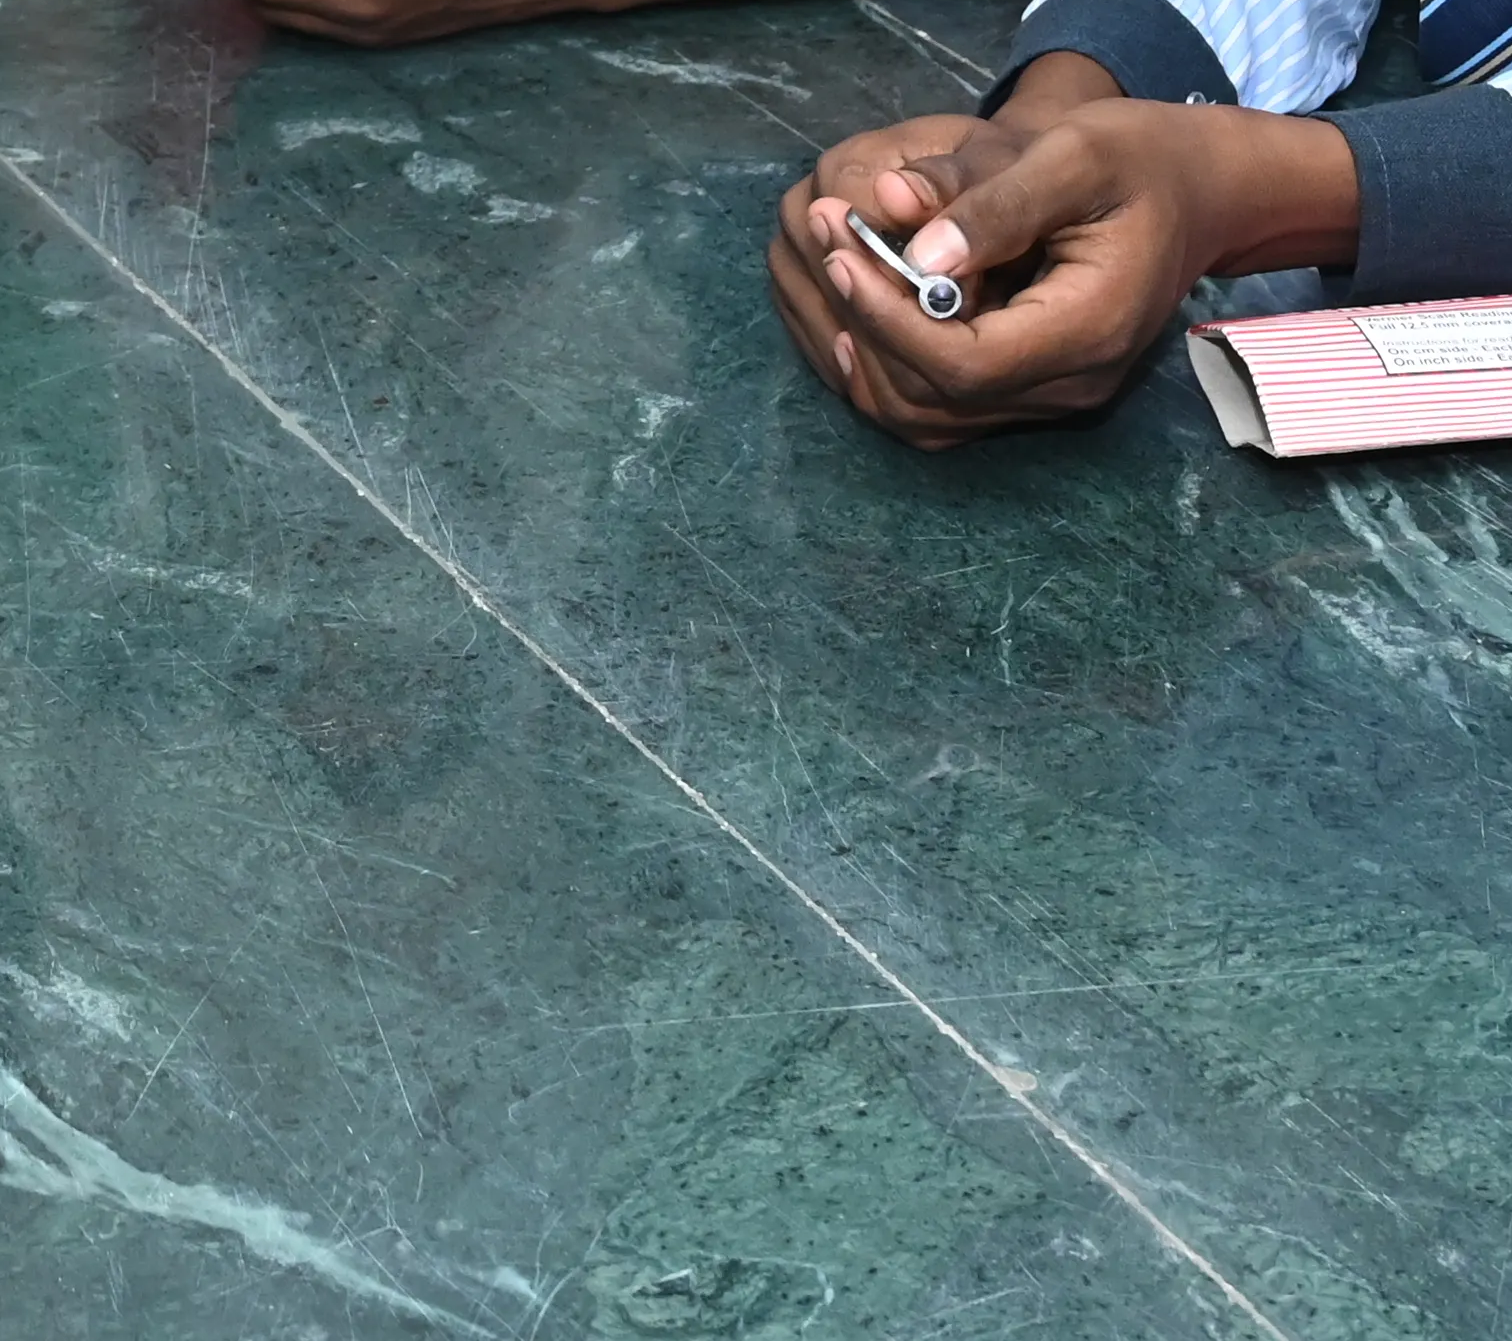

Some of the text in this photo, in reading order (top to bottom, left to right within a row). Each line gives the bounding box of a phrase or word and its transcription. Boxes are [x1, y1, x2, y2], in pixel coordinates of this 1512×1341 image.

[1417, 312, 1456, 320] Scale
[1462, 337, 1479, 345] for
[1393, 357, 1416, 366] On
[1419, 356, 1451, 365] inch
[1454, 355, 1484, 363] side
